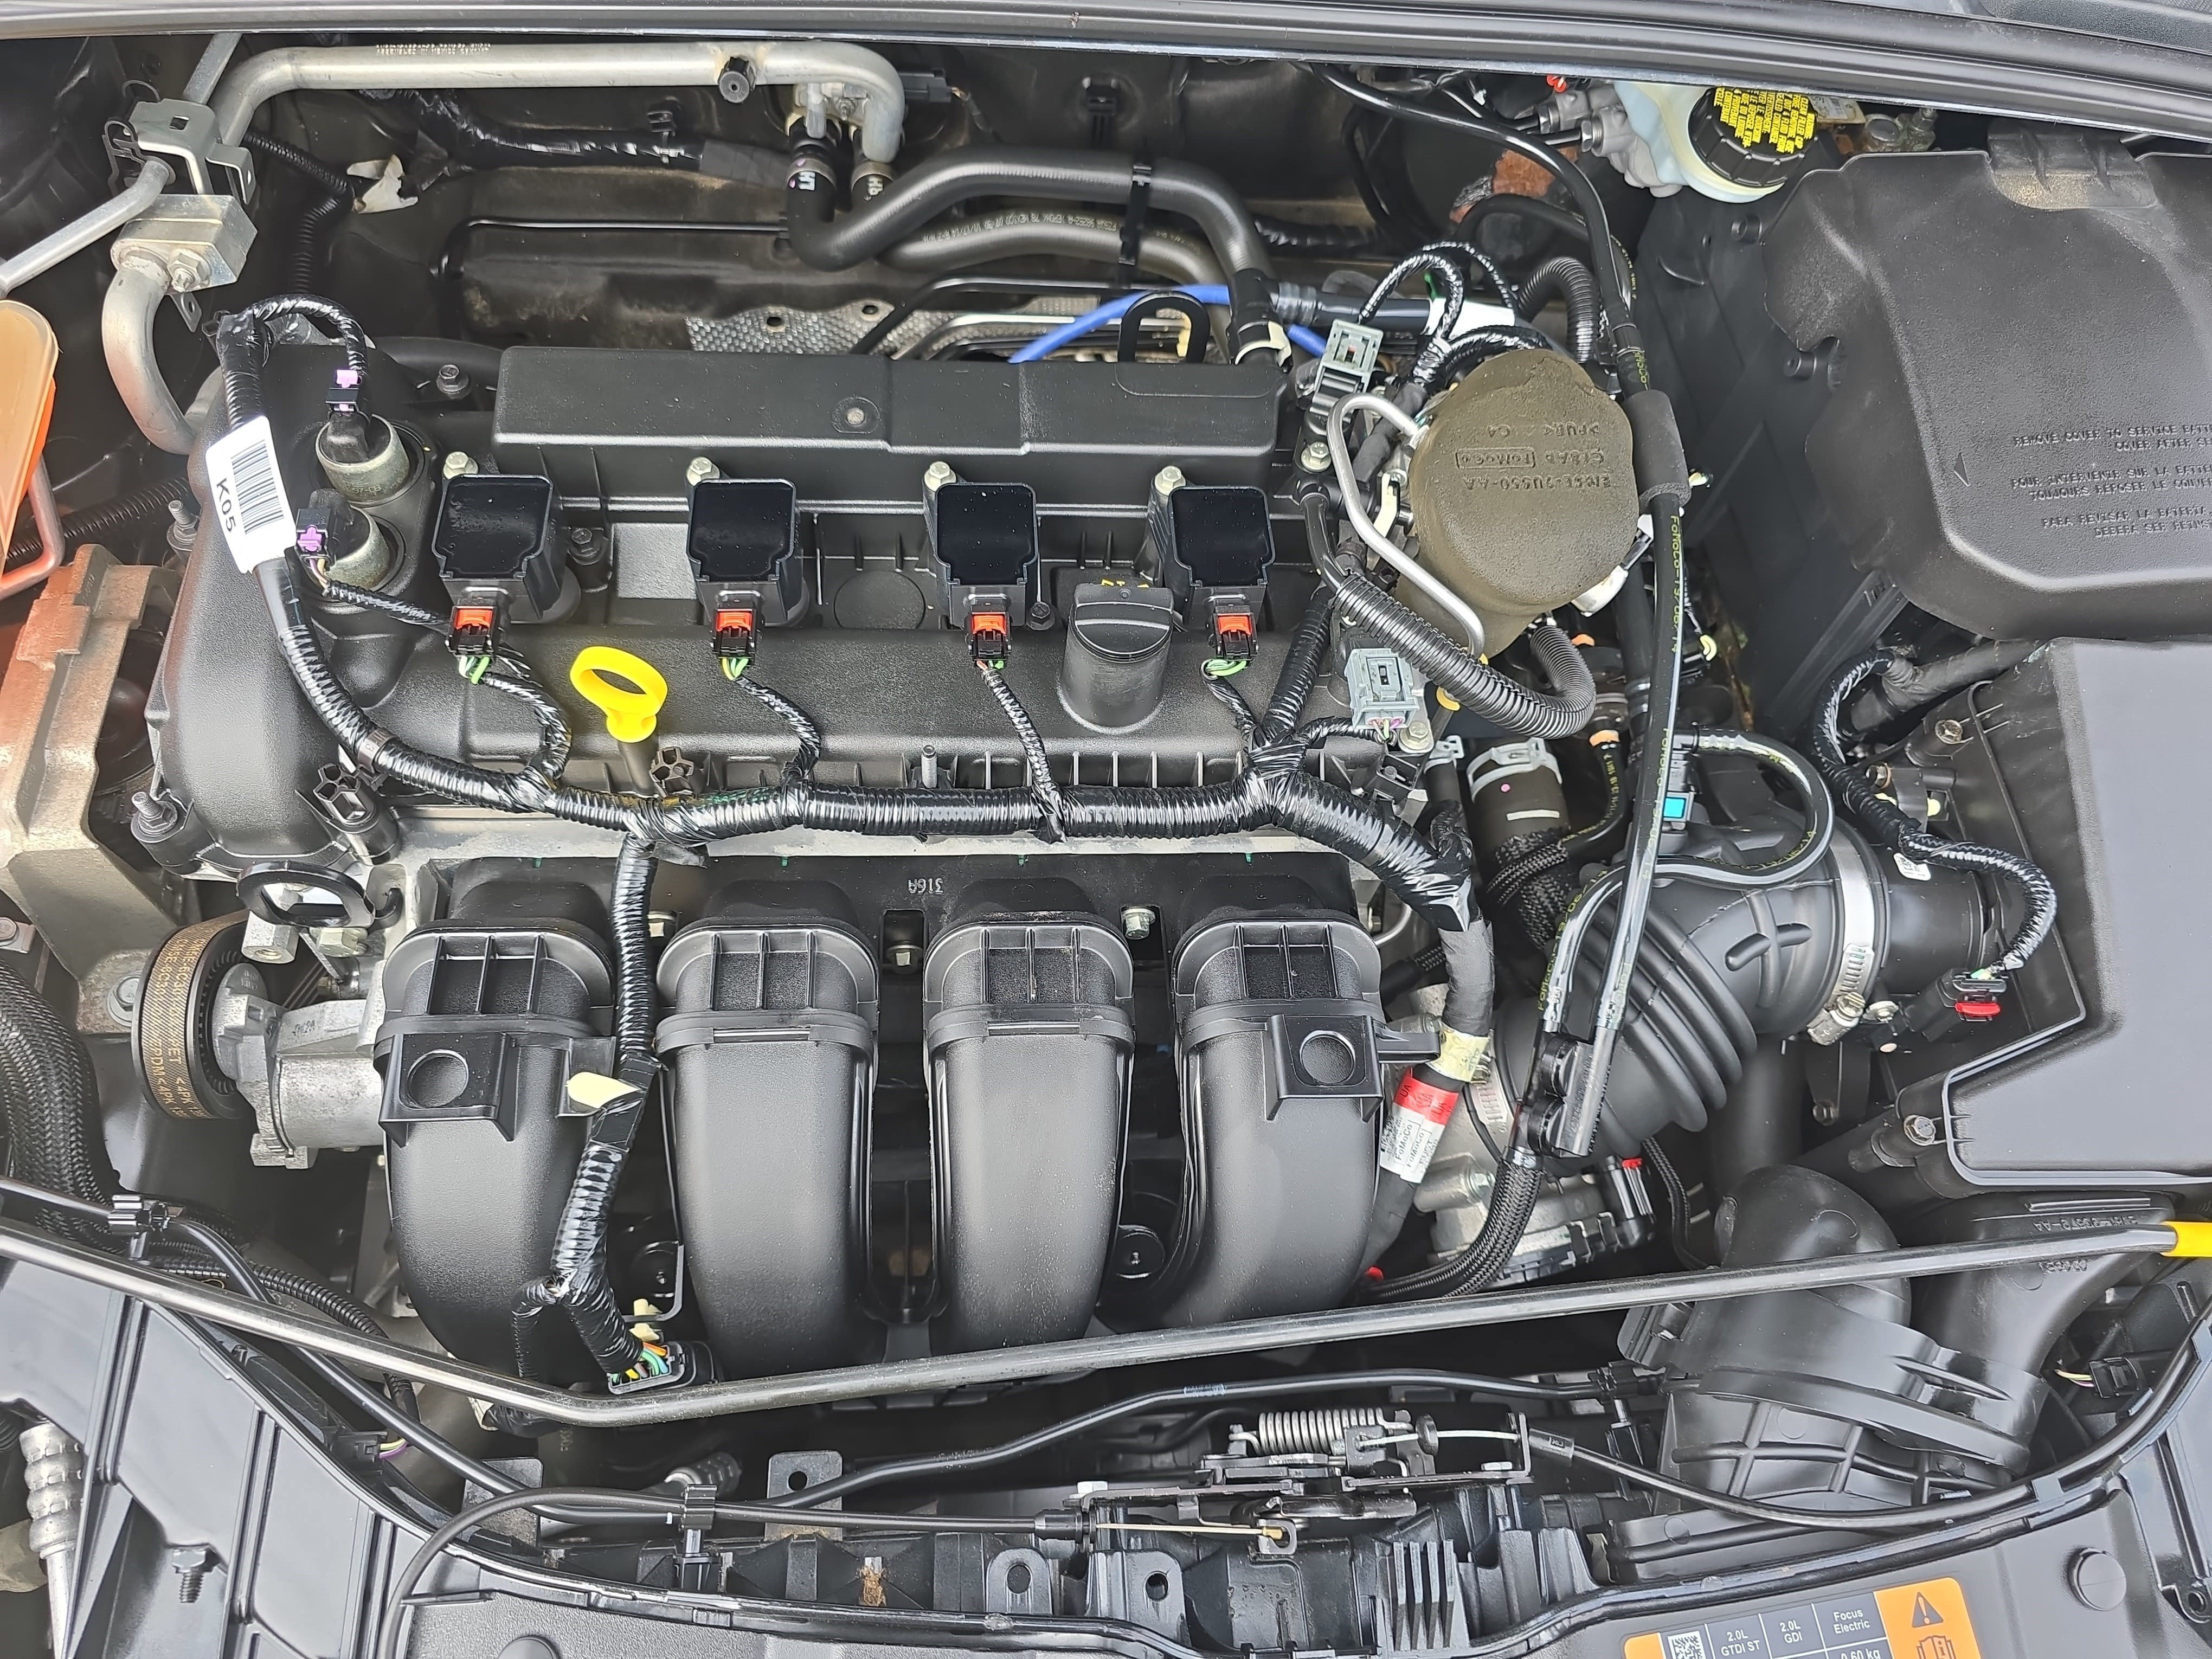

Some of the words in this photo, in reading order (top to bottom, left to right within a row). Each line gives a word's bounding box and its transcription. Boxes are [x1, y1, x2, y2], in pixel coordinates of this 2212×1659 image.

[1720, 91, 1733, 124] CONTENANT
[1741, 93, 1750, 105] QUE
[1750, 95, 1758, 104] LE
[1783, 99, 1792, 111] DOT
[1799, 97, 1809, 115] CLEAN
[1728, 95, 1741, 128] PROVENANT
[1739, 105, 1748, 115] DU
[1756, 105, 1765, 114] LE
[1735, 115, 1746, 139] LIQUIDE
[1752, 114, 1763, 143] BOUCHON
[1779, 117, 1789, 134] FLUID
[1796, 115, 1806, 136] FILLER
[1776, 134, 1787, 153] FROM
[2014, 433, 2060, 447] REMOVE
[2064, 430, 2102, 442] COVER
[2106, 428, 2123, 439] TO
[2127, 425, 2178, 438] SERVICE
[2115, 440, 2152, 452] COVER
[2157, 438, 2191, 449] AFTER
[2011, 477, 2042, 490] POUR
[2047, 470, 2123, 485] INTERVENIR
[2127, 468, 2150, 479] SUR
[2155, 467, 2171, 477] LA
[2029, 486, 2091, 501] TOUJOURS
[2095, 482, 2147, 495] REPOSER
[2152, 480, 2169, 491] LE
[216, 478, 236, 532] K05
[2042, 516, 2074, 529] PARA
[2079, 511, 2132, 525] REVISAR
[2095, 523, 2138, 538] DEBERA
[2144, 522, 2168, 533] SER
[908, 878, 944, 895] 316A
[1399, 1084, 1413, 1097] UA
[1431, 1102, 1447, 1115] UA
[1396, 1124, 1413, 1160] FoMoCo
[1833, 1609, 1864, 1622] Focus
[1779, 1619, 1801, 1632] 2.0L
[1833, 1621, 1870, 1635] Electric
[1727, 1629, 1748, 1642] 2.0L
[1784, 1631, 1803, 1644] GDI
[1721, 1643, 1746, 1657] GTDI
[1747, 1639, 1760, 1651] ST
